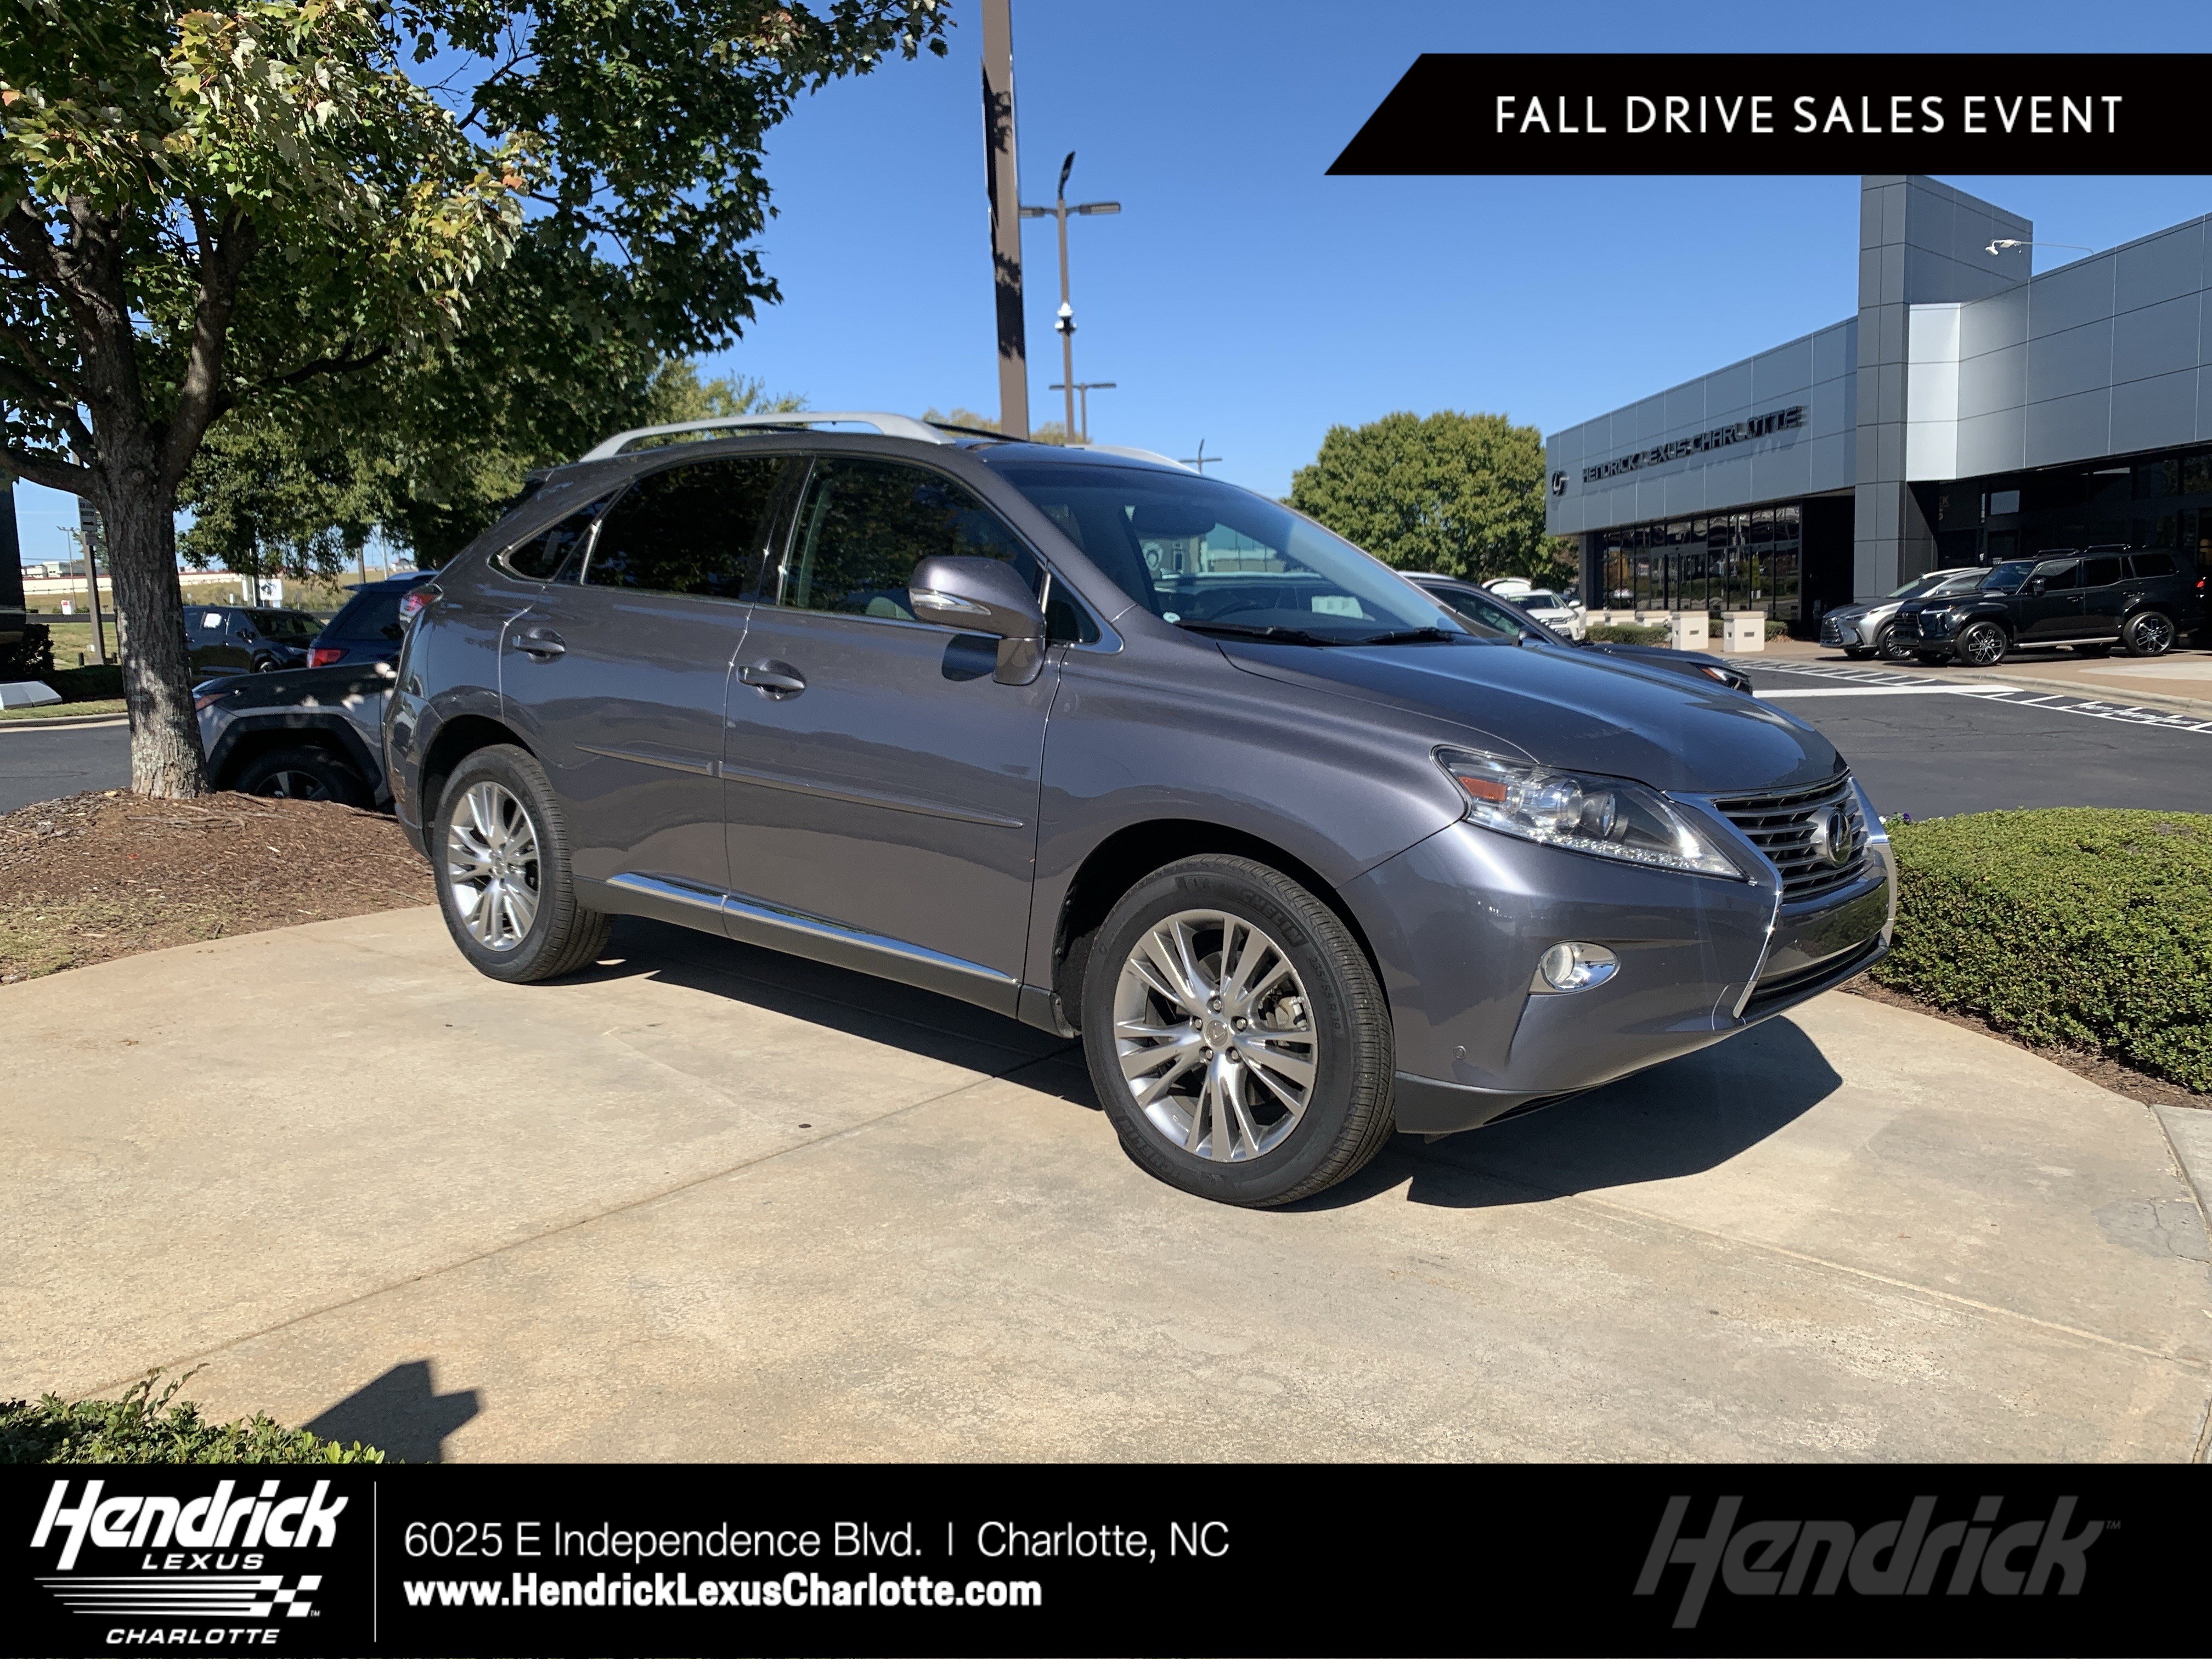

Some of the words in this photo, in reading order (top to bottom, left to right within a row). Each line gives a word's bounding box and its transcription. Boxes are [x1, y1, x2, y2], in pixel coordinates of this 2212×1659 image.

[1582, 451, 1641, 483] HENDRICK
[1641, 438, 1691, 468] LEXUS
[1691, 405, 1806, 455] CHARLOTTE
